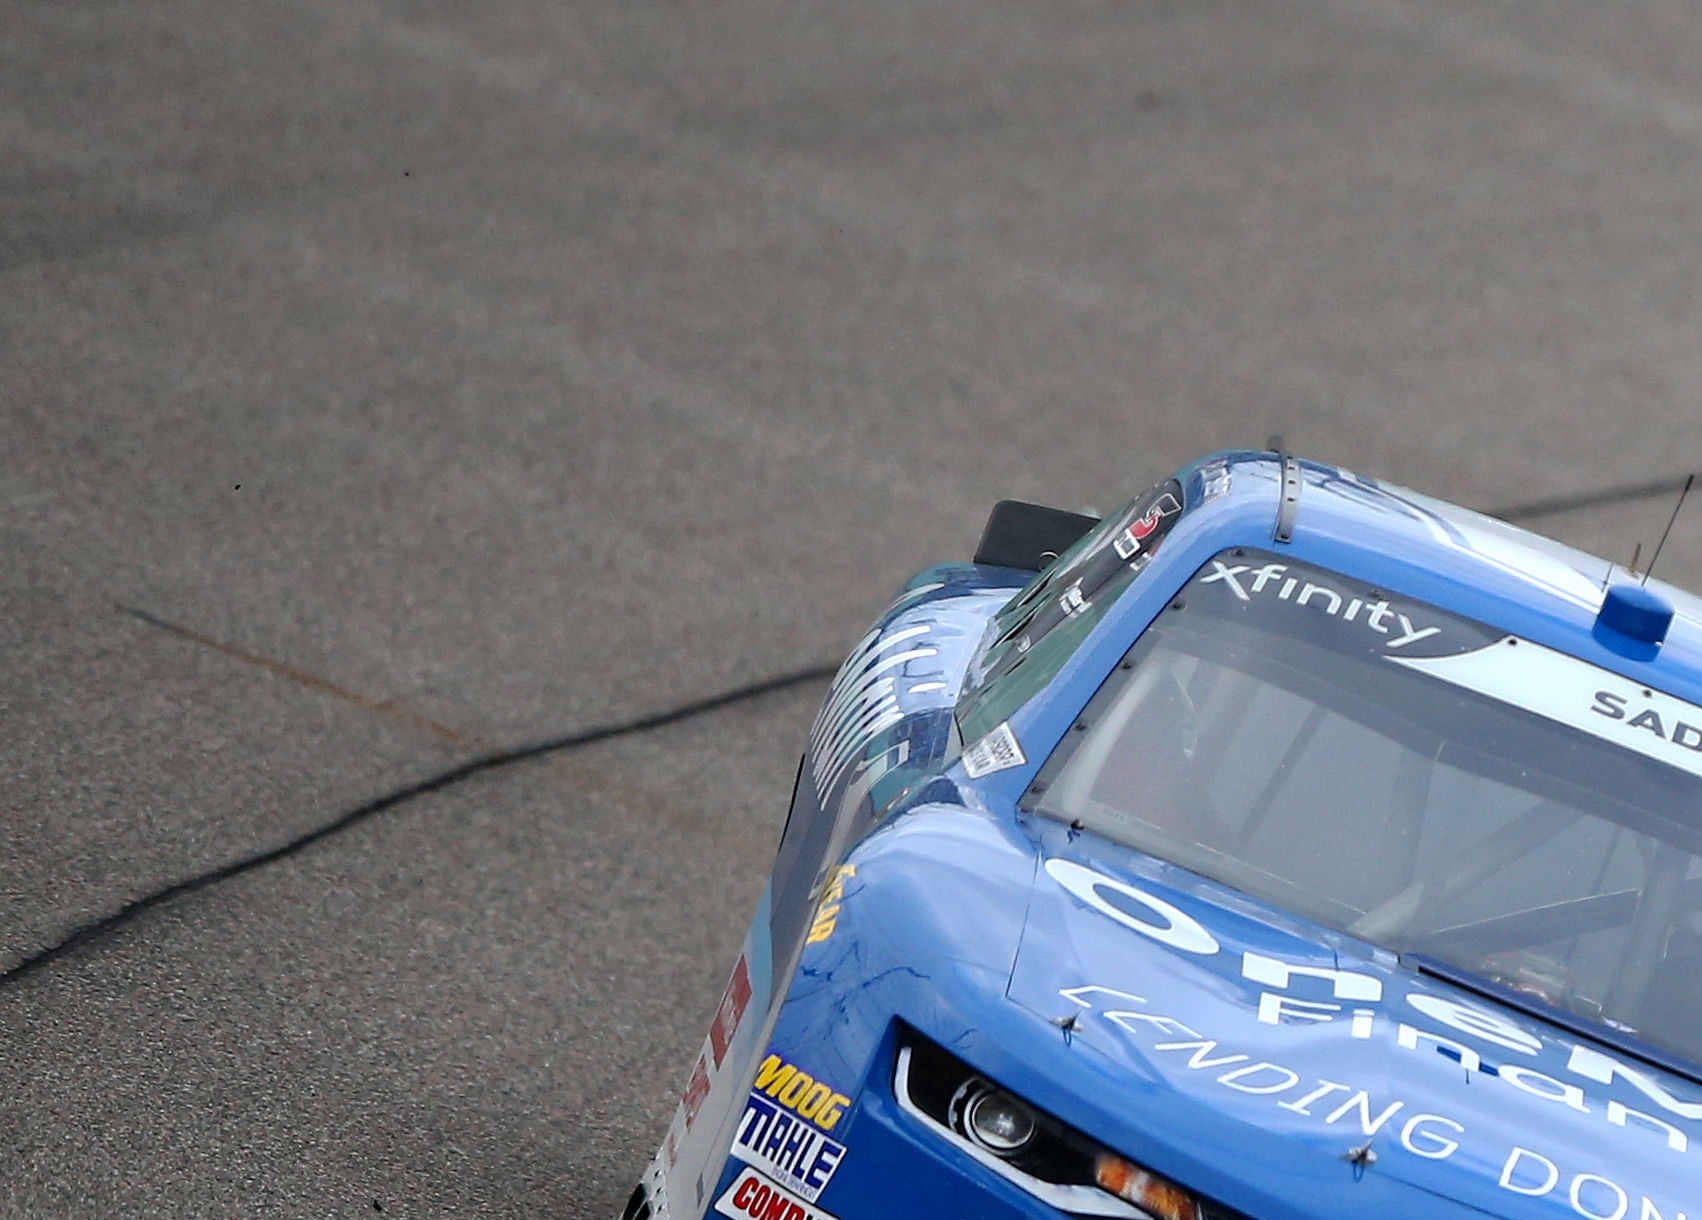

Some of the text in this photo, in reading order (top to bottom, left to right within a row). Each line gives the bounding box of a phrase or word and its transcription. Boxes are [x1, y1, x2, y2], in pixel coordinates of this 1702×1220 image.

[1200, 560, 1441, 649] xfinity
[754, 1054, 851, 1131] MOOG
[1059, 985, 1465, 1159] LENDING
[739, 1098, 842, 1190] MAHLE
